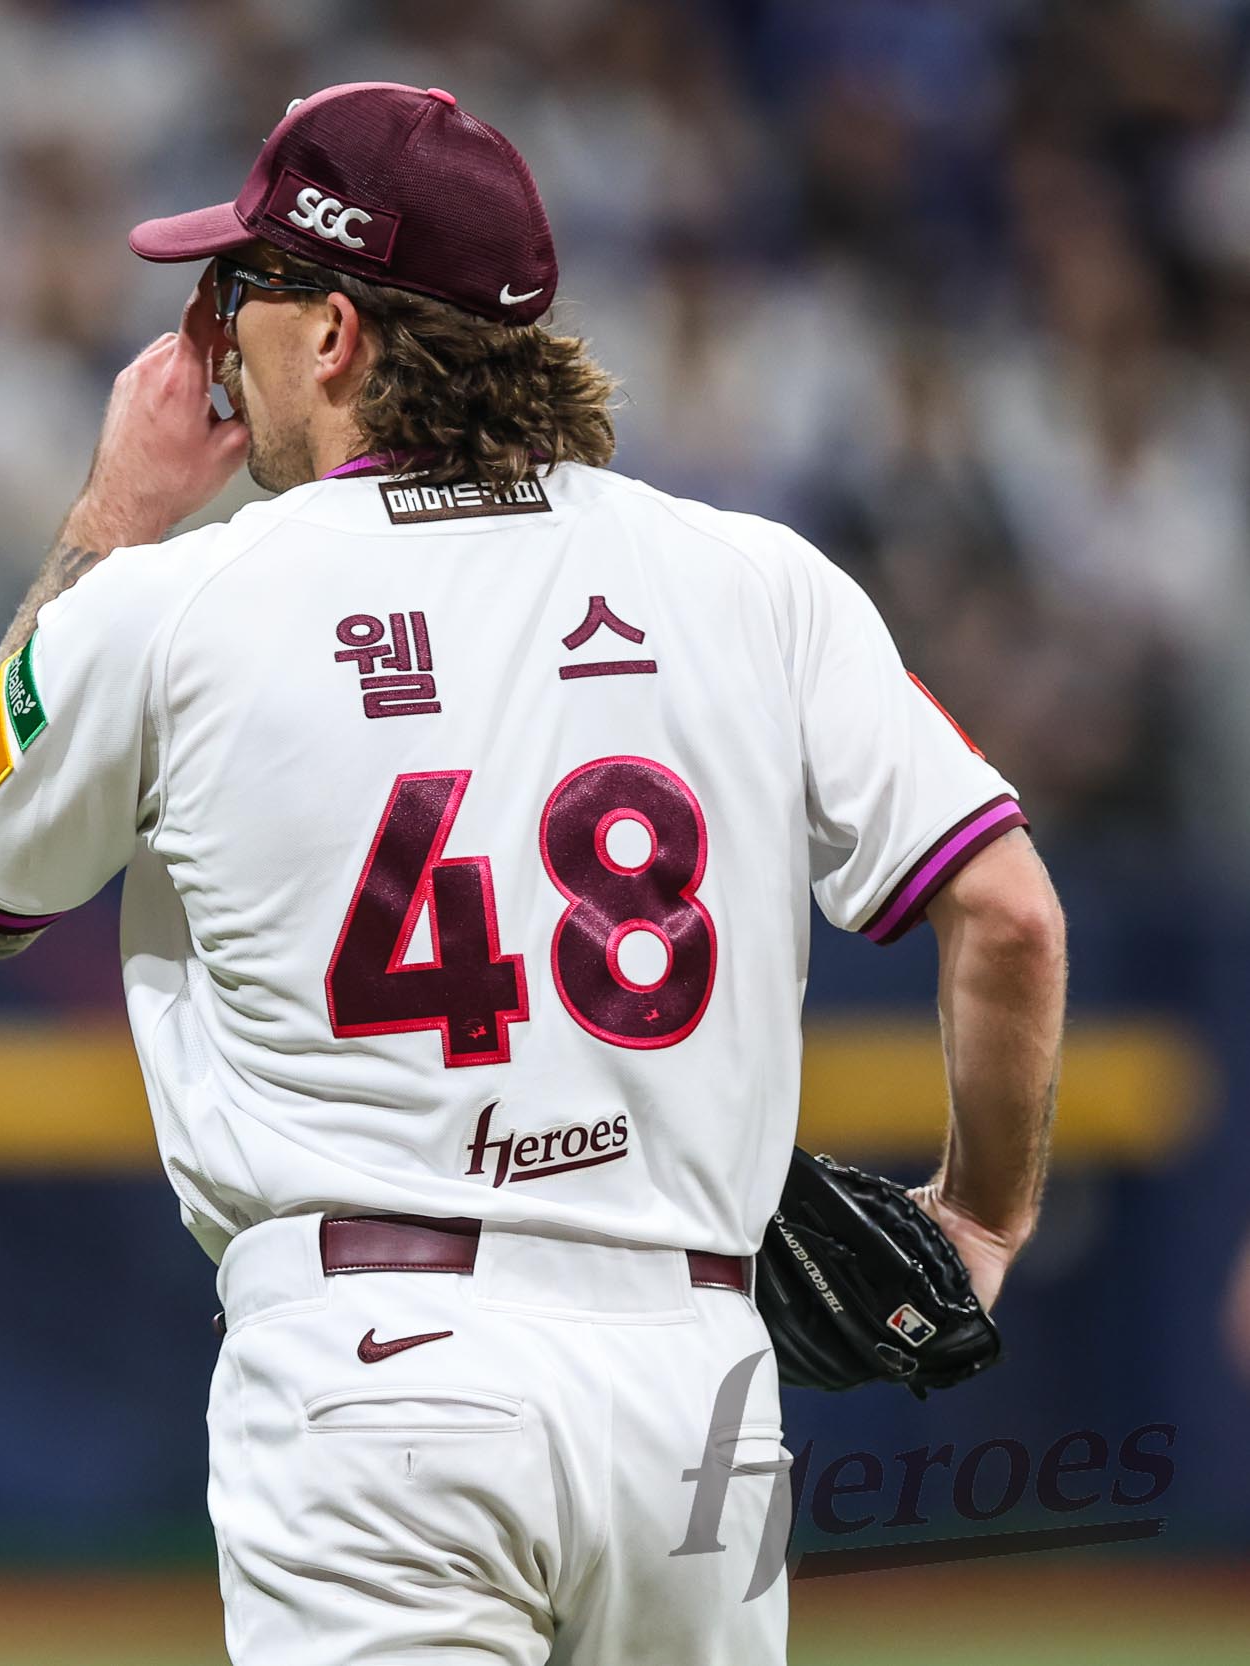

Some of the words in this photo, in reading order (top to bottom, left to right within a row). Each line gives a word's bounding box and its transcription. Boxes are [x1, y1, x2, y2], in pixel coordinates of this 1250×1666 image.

[287, 187, 373, 249] SGC
[8, 656, 26, 717] balife
[324, 755, 718, 1069] 48
[464, 1100, 629, 1189] Heroes
[803, 1260, 829, 1291] GOLD
[821, 1289, 844, 1314] THE
